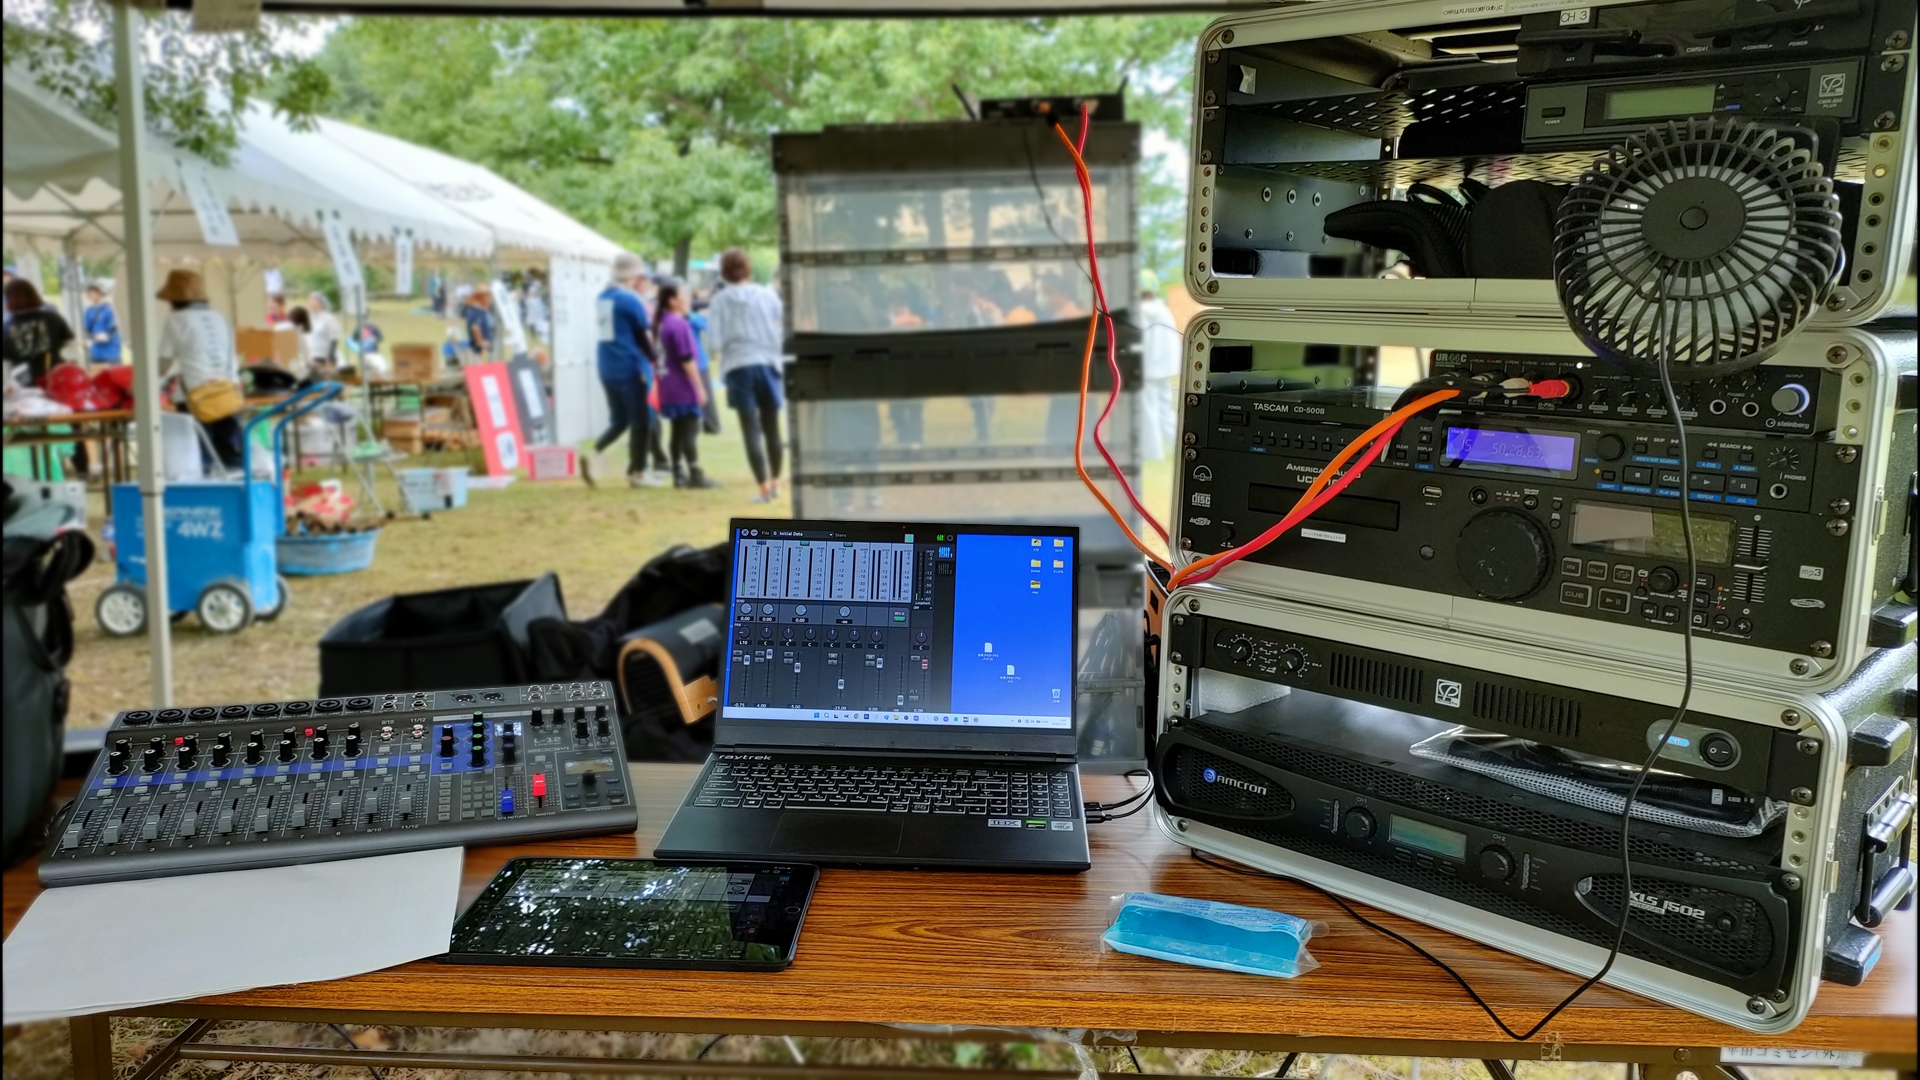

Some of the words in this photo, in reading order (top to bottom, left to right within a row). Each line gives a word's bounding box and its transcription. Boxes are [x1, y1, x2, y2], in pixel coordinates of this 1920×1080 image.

[1560, 12, 1576, 23] CH
[1580, 10, 1588, 20] 3
[1253, 403, 1289, 413] TASCAM
[1294, 406, 1325, 415] CD-500B
[1777, 420, 1810, 429] steinberg
[1286, 463, 1323, 474] AMERICA
[177, 520, 224, 540] 4WZ
[1801, 568, 1822, 578] mp3
[1565, 591, 1585, 599] CUE
[1629, 890, 1658, 906] XLS
[1662, 900, 1706, 920] 1502
